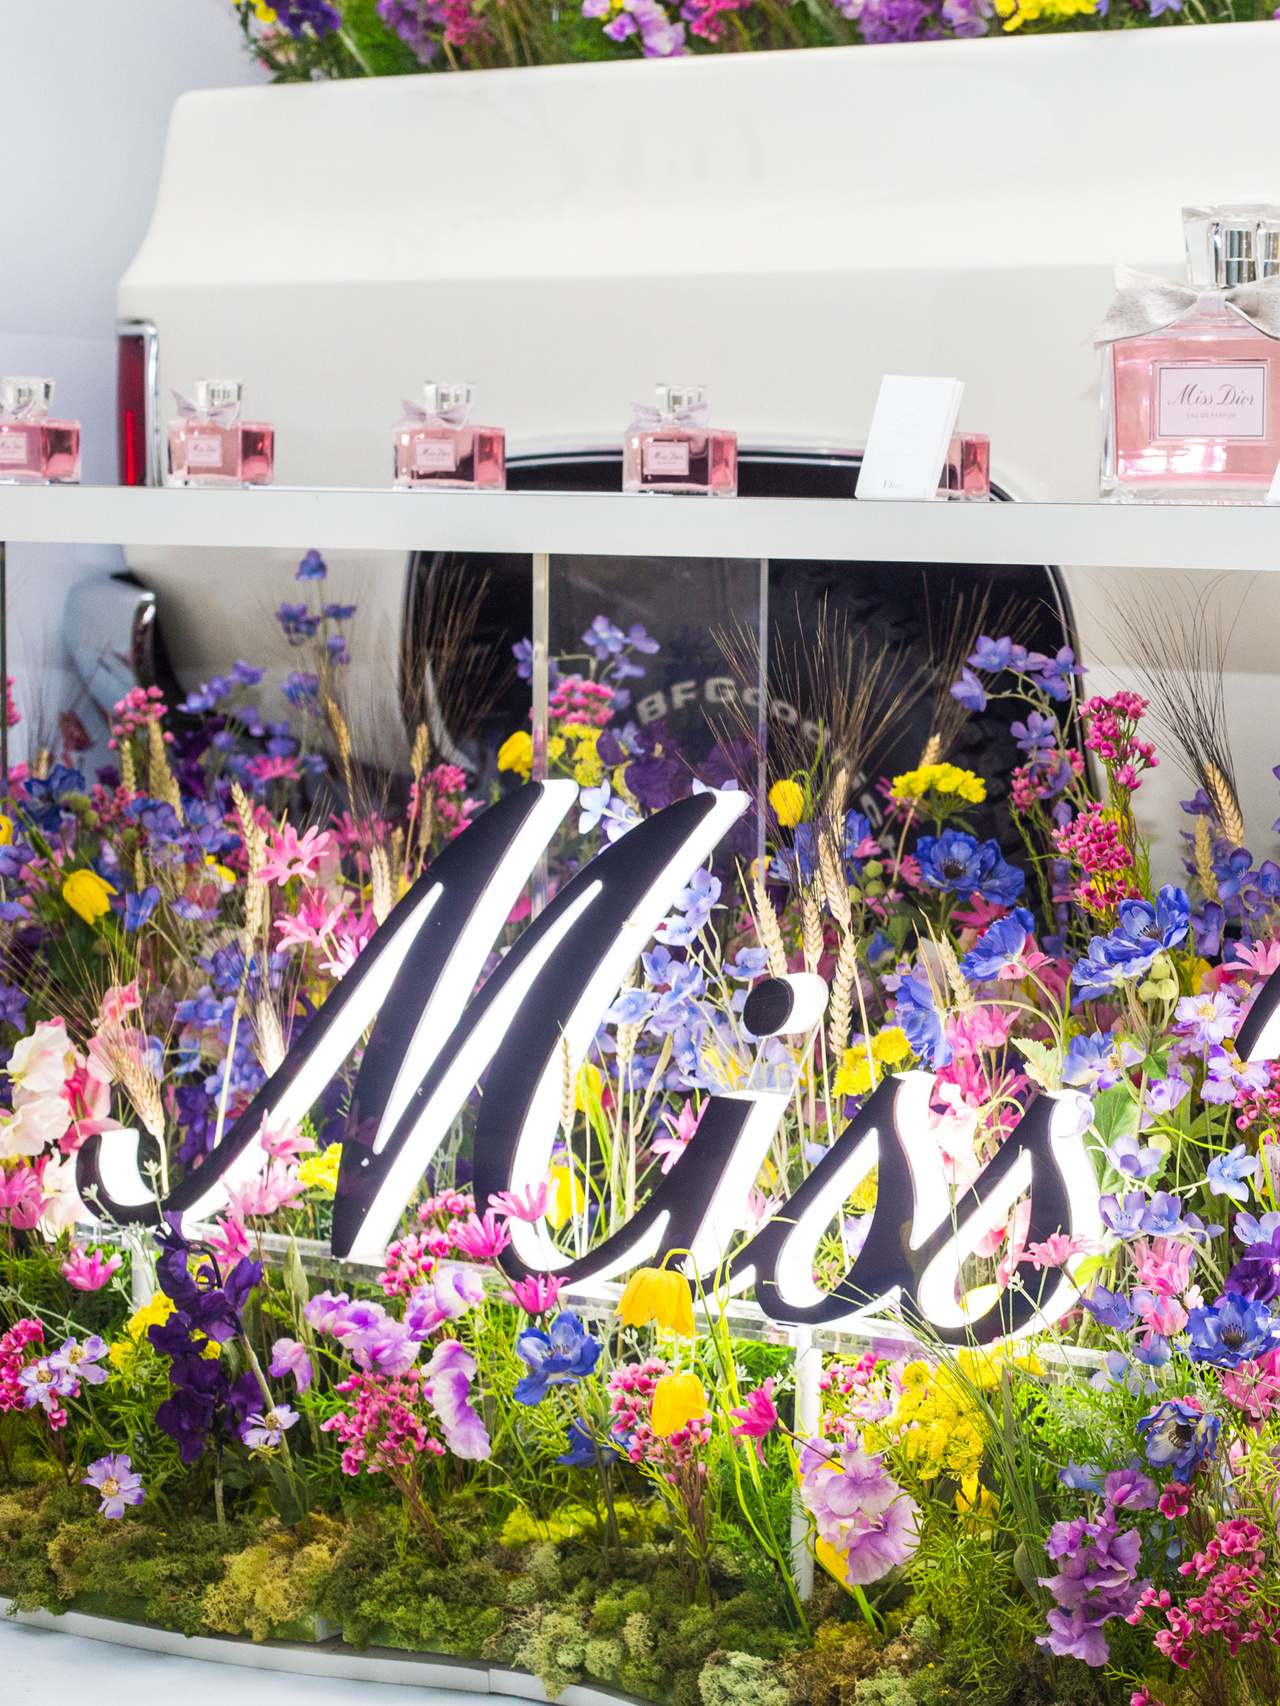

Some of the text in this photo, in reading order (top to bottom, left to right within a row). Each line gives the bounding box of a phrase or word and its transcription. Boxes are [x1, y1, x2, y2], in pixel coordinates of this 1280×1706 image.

[1167, 383, 1255, 406] Miss Dior
[882, 479, 904, 490] Dior
[76, 779, 1102, 1345] Miss
